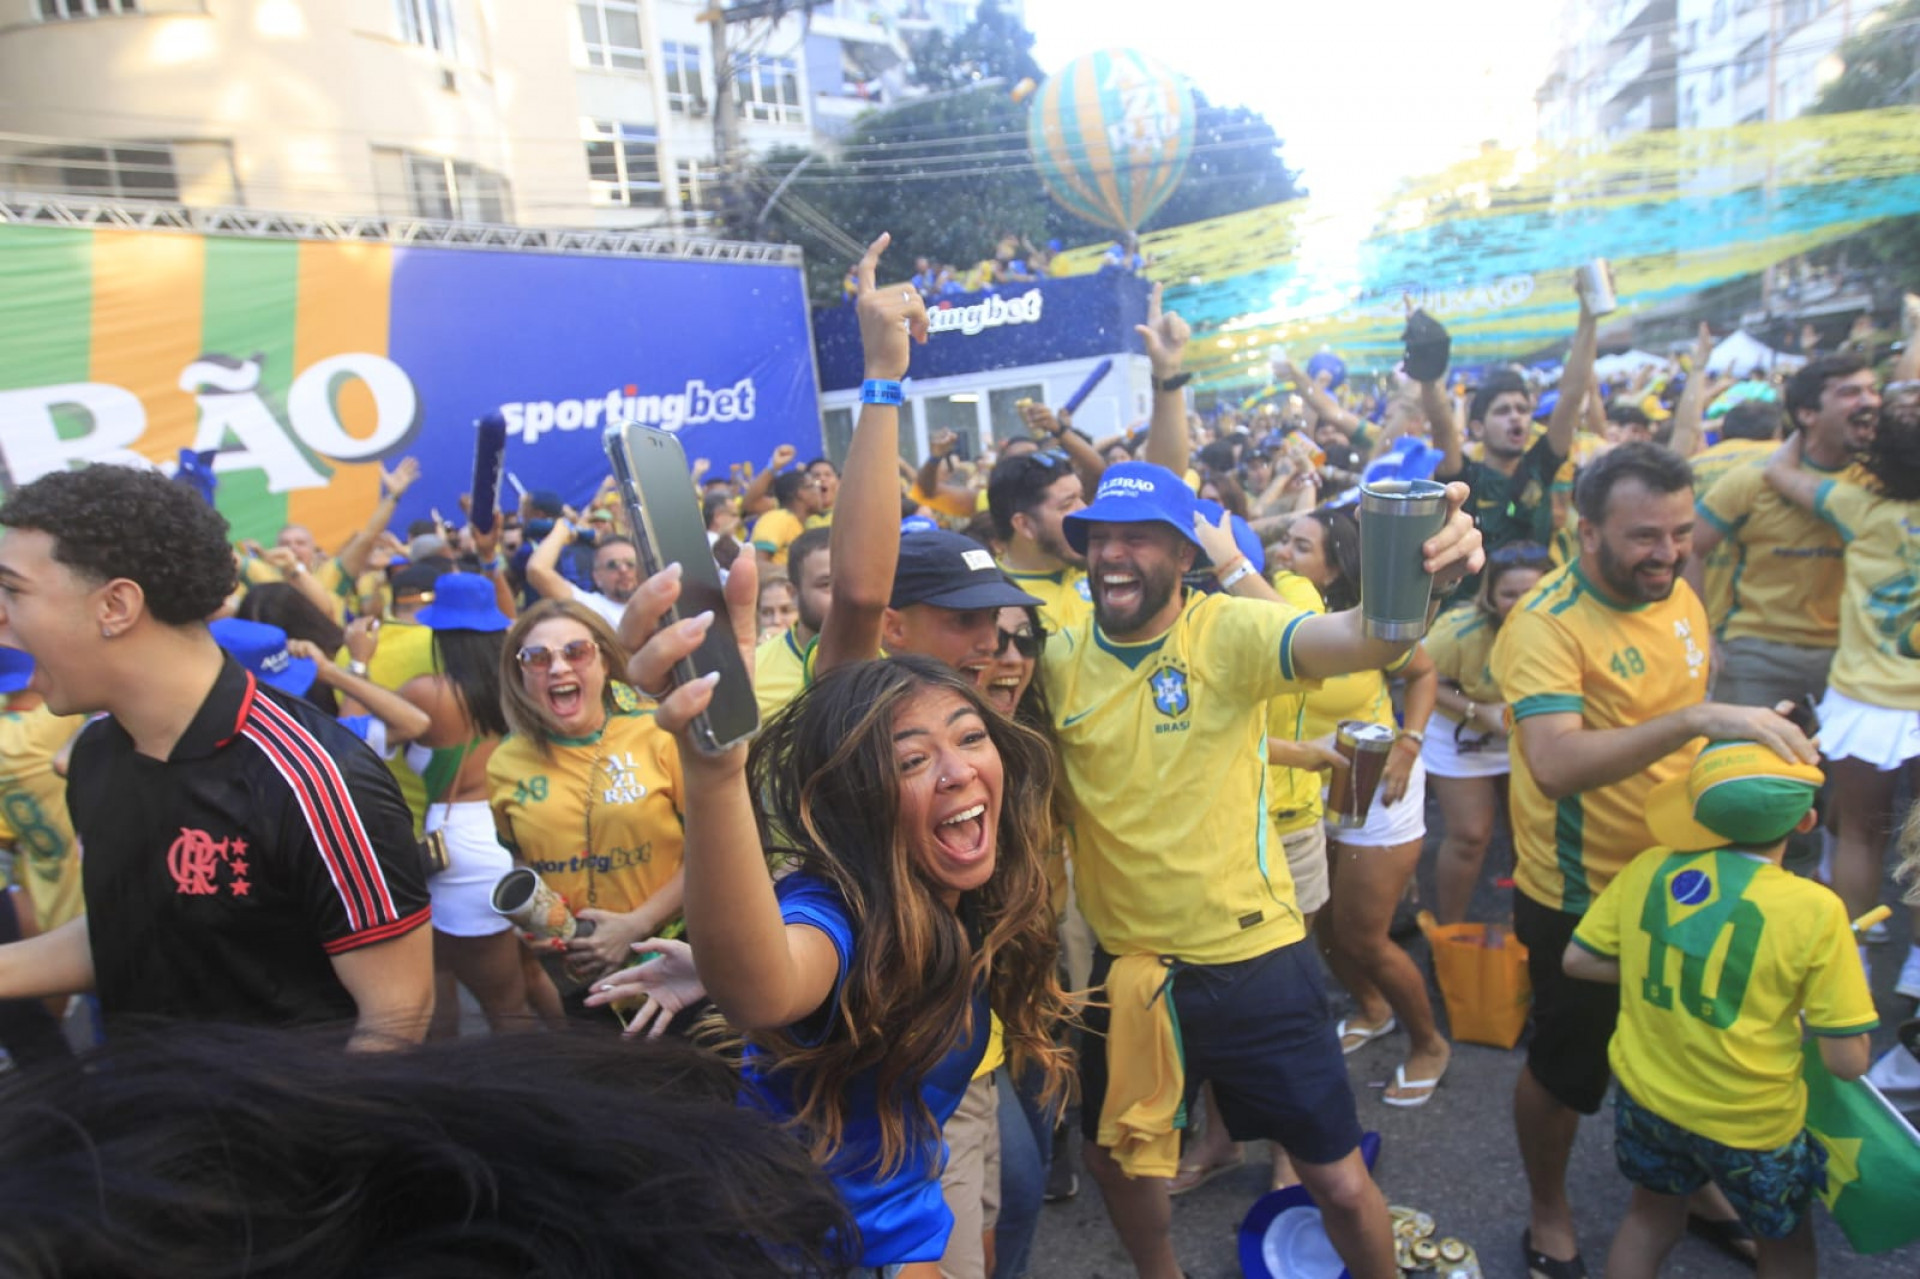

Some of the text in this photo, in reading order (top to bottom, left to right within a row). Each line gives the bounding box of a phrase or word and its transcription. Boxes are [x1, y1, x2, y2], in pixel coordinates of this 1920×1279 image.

[926, 287, 1043, 336] tingbet
[499, 377, 756, 444] sportingbet
[1611, 647, 1645, 679] 48
[1155, 720, 1191, 734] BRASI
[605, 751, 639, 774] AL
[530, 843, 652, 873] portgbet
